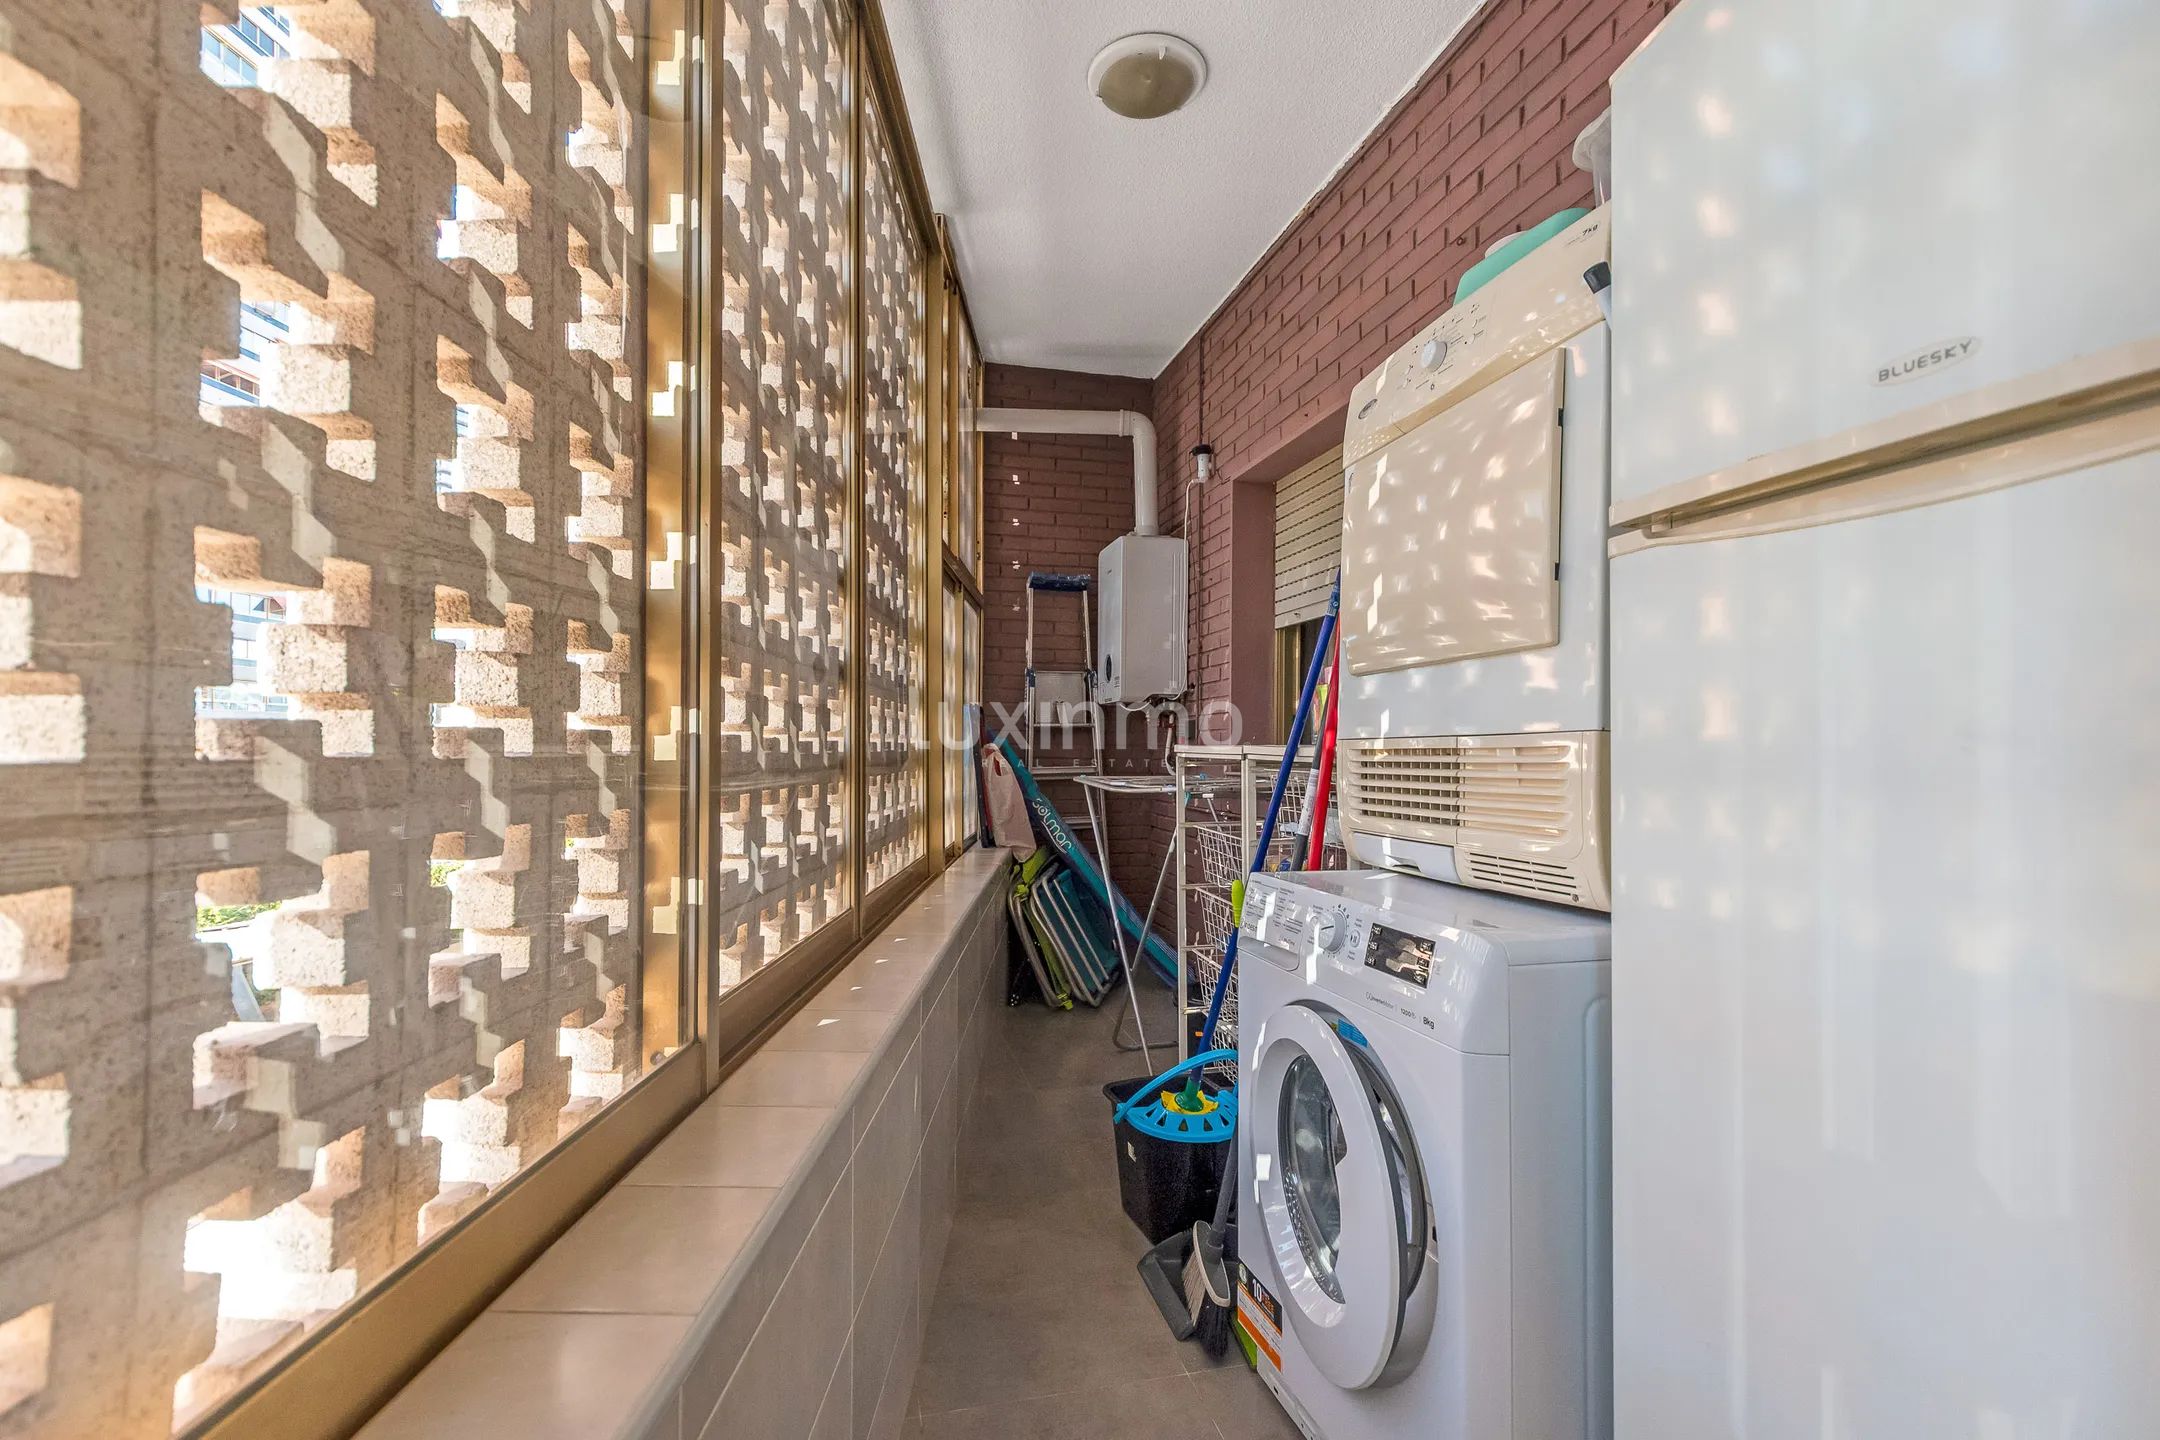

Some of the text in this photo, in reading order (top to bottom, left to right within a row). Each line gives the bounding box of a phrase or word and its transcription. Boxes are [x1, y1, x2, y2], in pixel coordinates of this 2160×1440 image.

[1878, 337, 1973, 382] BLUESKY
[1423, 1016, 1435, 1030] 8kg
[1252, 1278, 1262, 1303] 10
